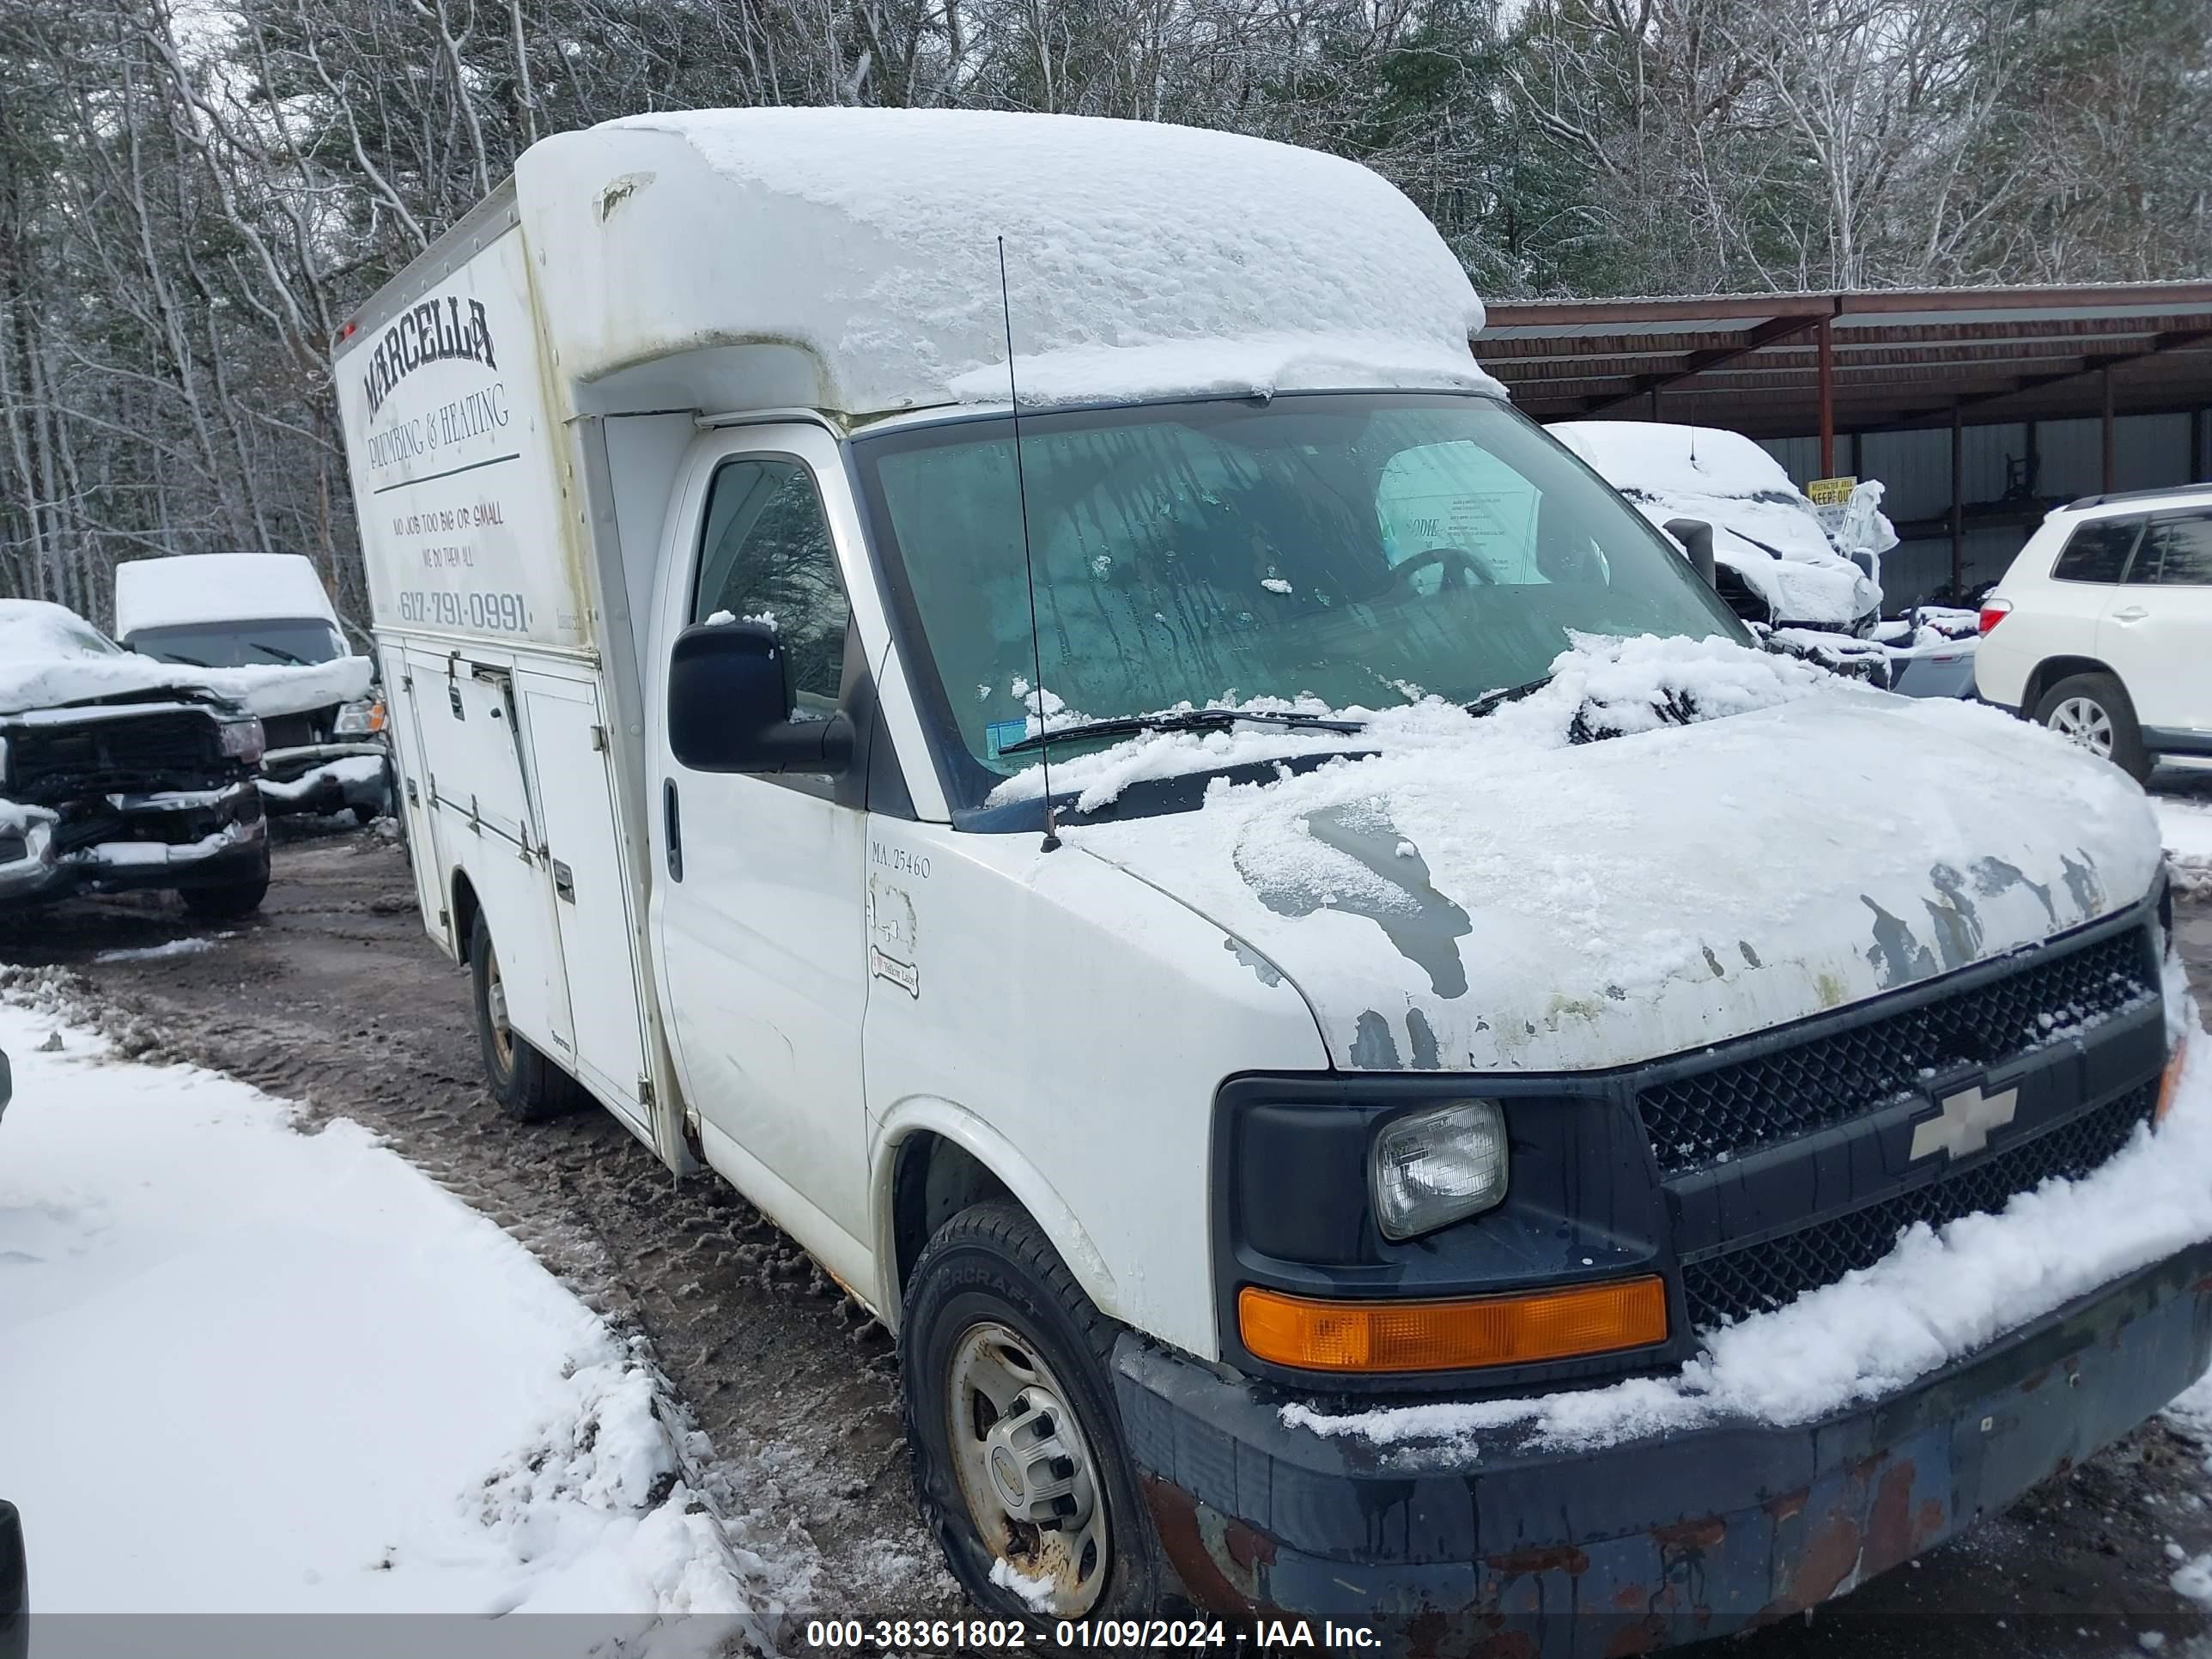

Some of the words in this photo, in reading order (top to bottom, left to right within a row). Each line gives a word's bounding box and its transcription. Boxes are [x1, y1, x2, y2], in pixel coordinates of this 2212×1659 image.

[363, 295, 498, 426] MARCELLA
[368, 420, 424, 470] PLUMBING
[426, 411, 438, 450] &
[440, 381, 510, 447] HEATING
[1812, 491, 1832, 506] KEEP
[406, 515, 420, 536] JOB
[422, 513, 438, 533] TOO
[440, 509, 454, 532] BIG
[457, 507, 471, 529] OR
[473, 501, 505, 528] SMALL
[442, 546, 460, 567] THEM
[883, 960, 901, 980] Yellow
